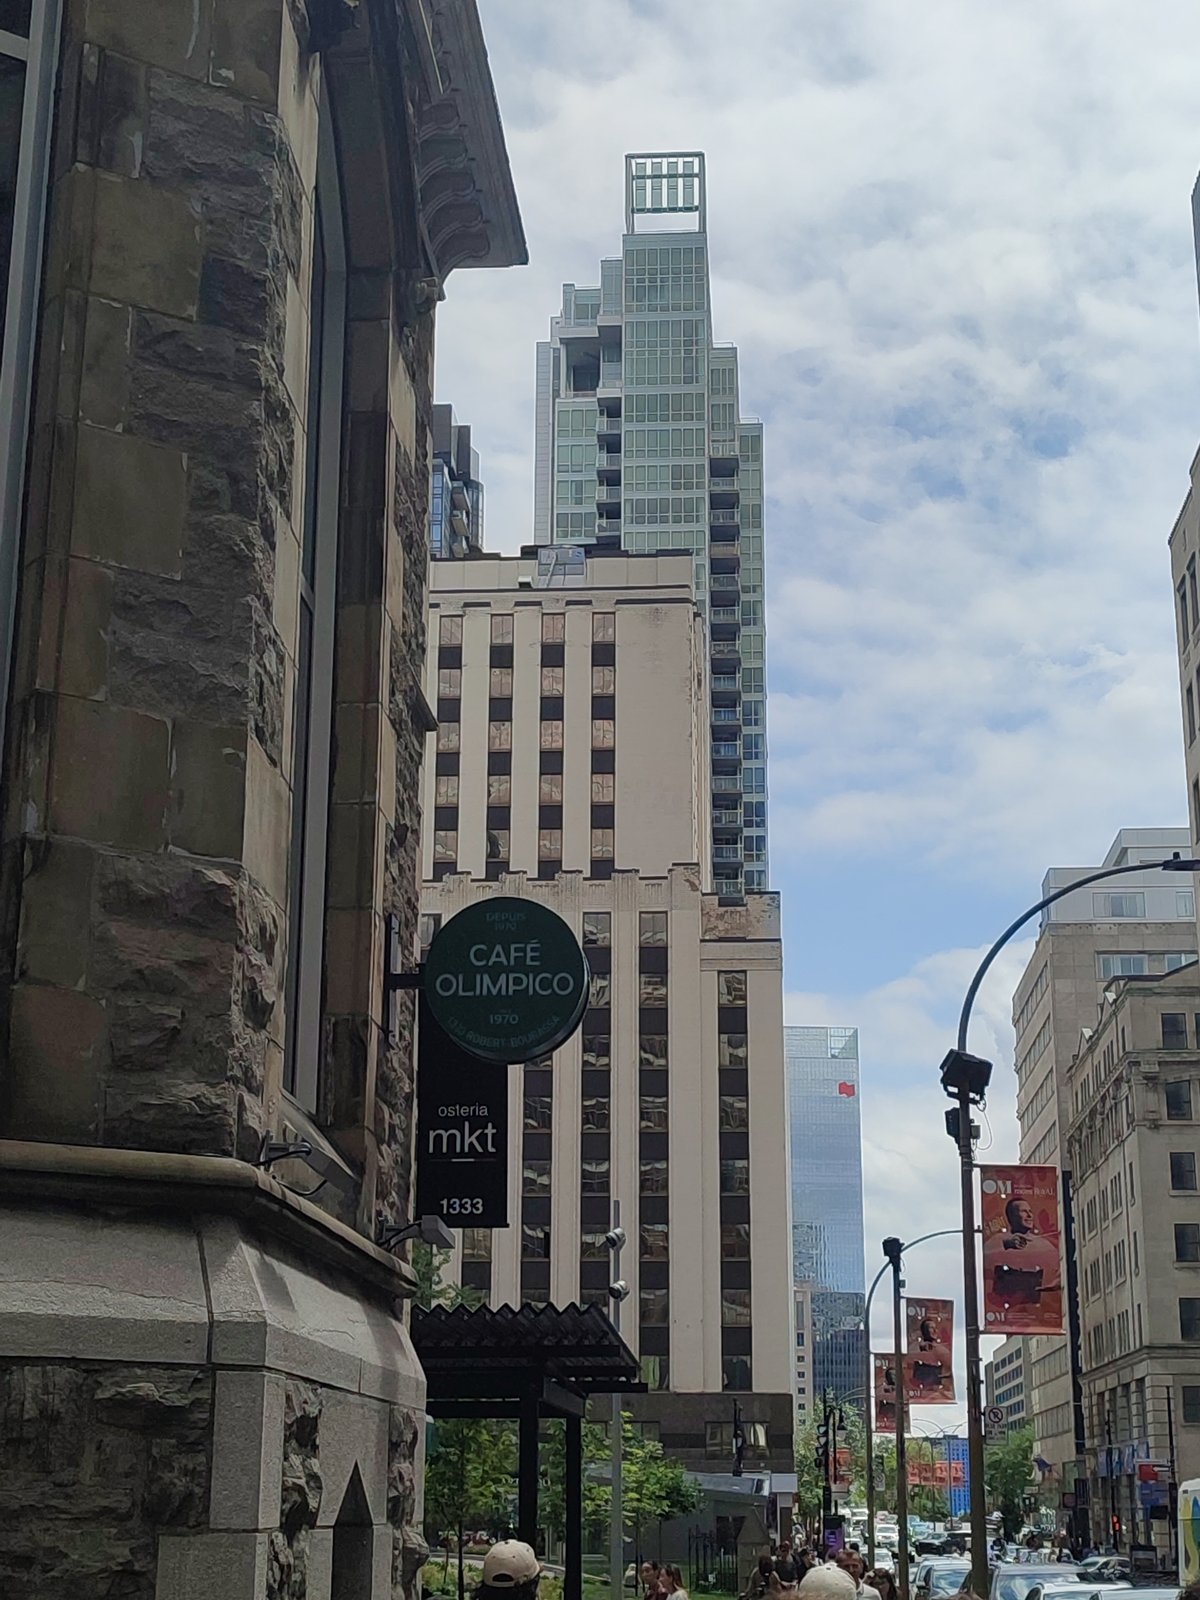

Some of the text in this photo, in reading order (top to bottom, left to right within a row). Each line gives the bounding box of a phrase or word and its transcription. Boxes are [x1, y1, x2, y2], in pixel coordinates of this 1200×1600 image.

[486, 912, 527, 922] DEPUIS
[469, 939, 541, 966] CAFÉ
[435, 972, 574, 997] OLIMPICO
[489, 1014, 520, 1025] 1970
[438, 1102, 489, 1117] osteria
[428, 1120, 497, 1154] mkt
[440, 1198, 483, 1214] 1333
